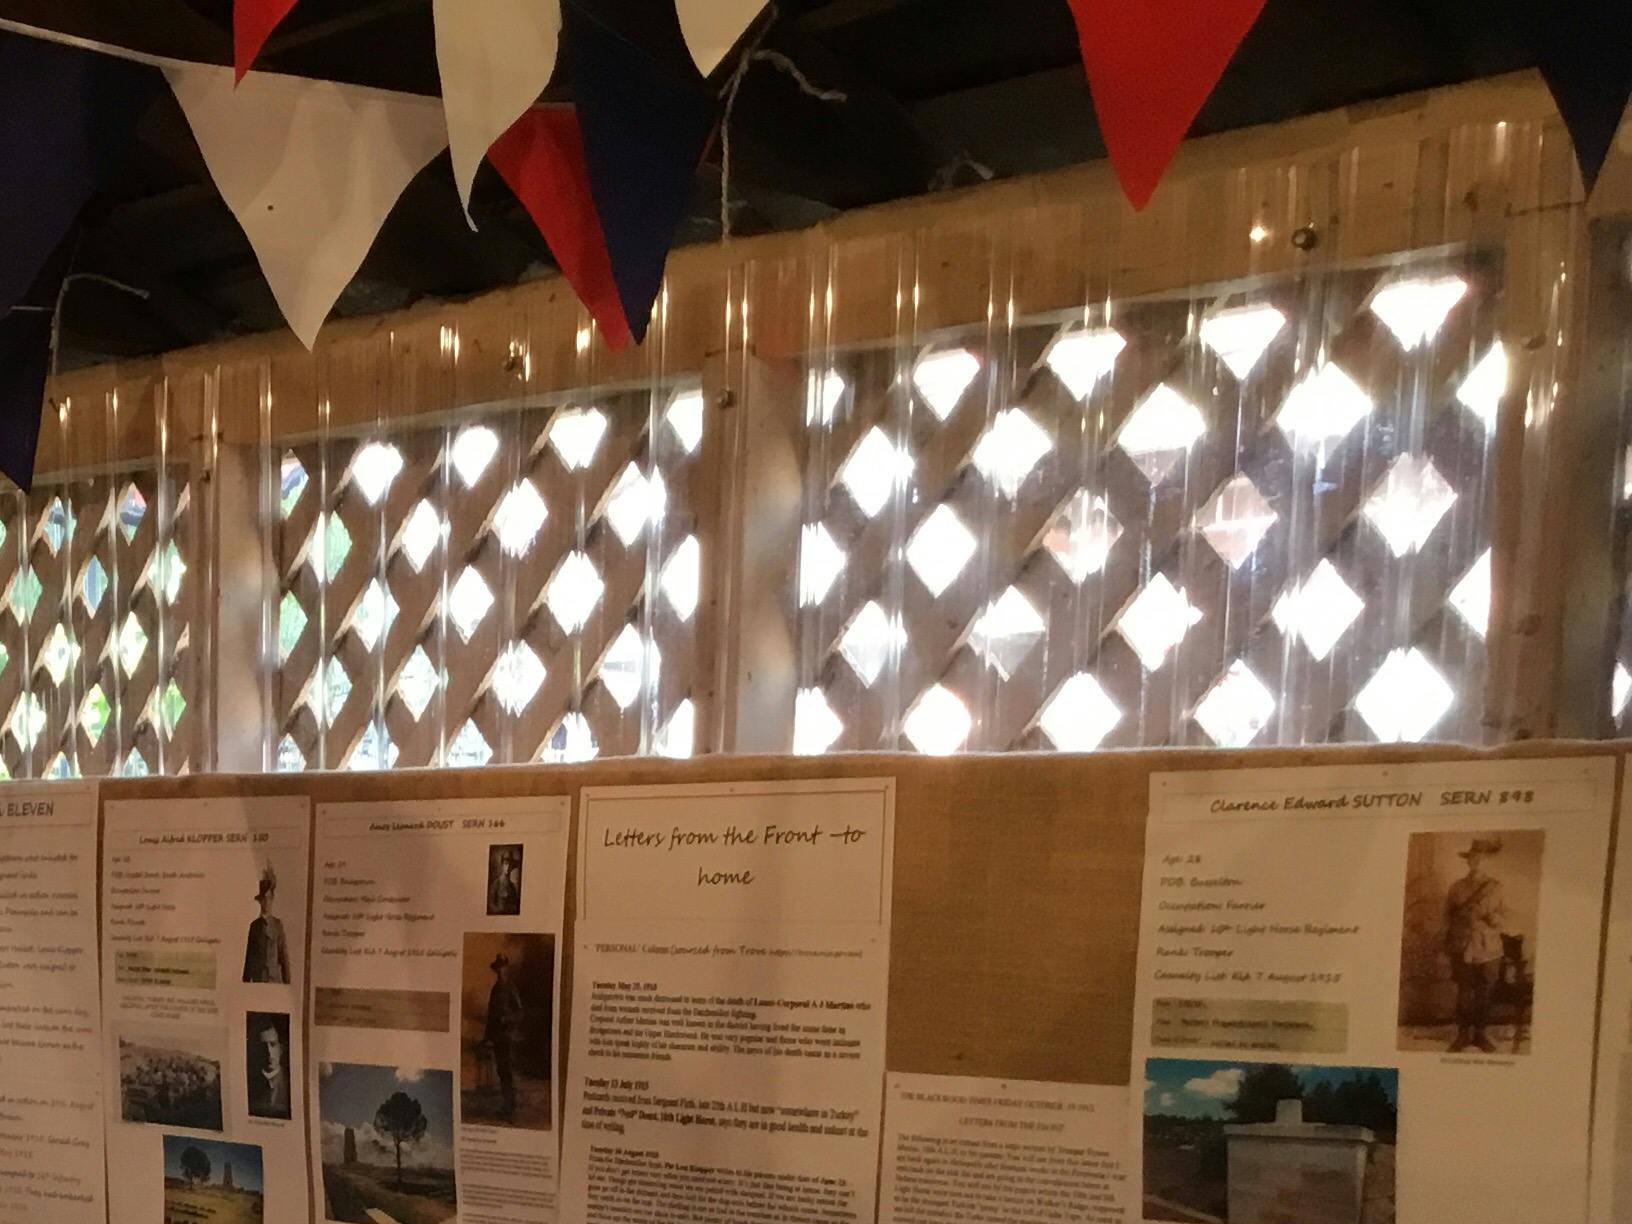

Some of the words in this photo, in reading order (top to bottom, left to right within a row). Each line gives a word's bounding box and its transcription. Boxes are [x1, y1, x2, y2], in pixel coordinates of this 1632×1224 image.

[7, 802, 54, 817] ELEVEN
[1210, 798, 1278, 814] Clarence
[1283, 796, 1348, 810] Edward
[1353, 792, 1422, 809] SUTTON
[1440, 790, 1492, 806] SERN
[603, 827, 665, 848] Letters
[668, 827, 718, 851] from
[723, 827, 758, 846] the
[763, 825, 823, 845] Front
[697, 866, 755, 887] home
[1304, 924, 1360, 938] Regiment
